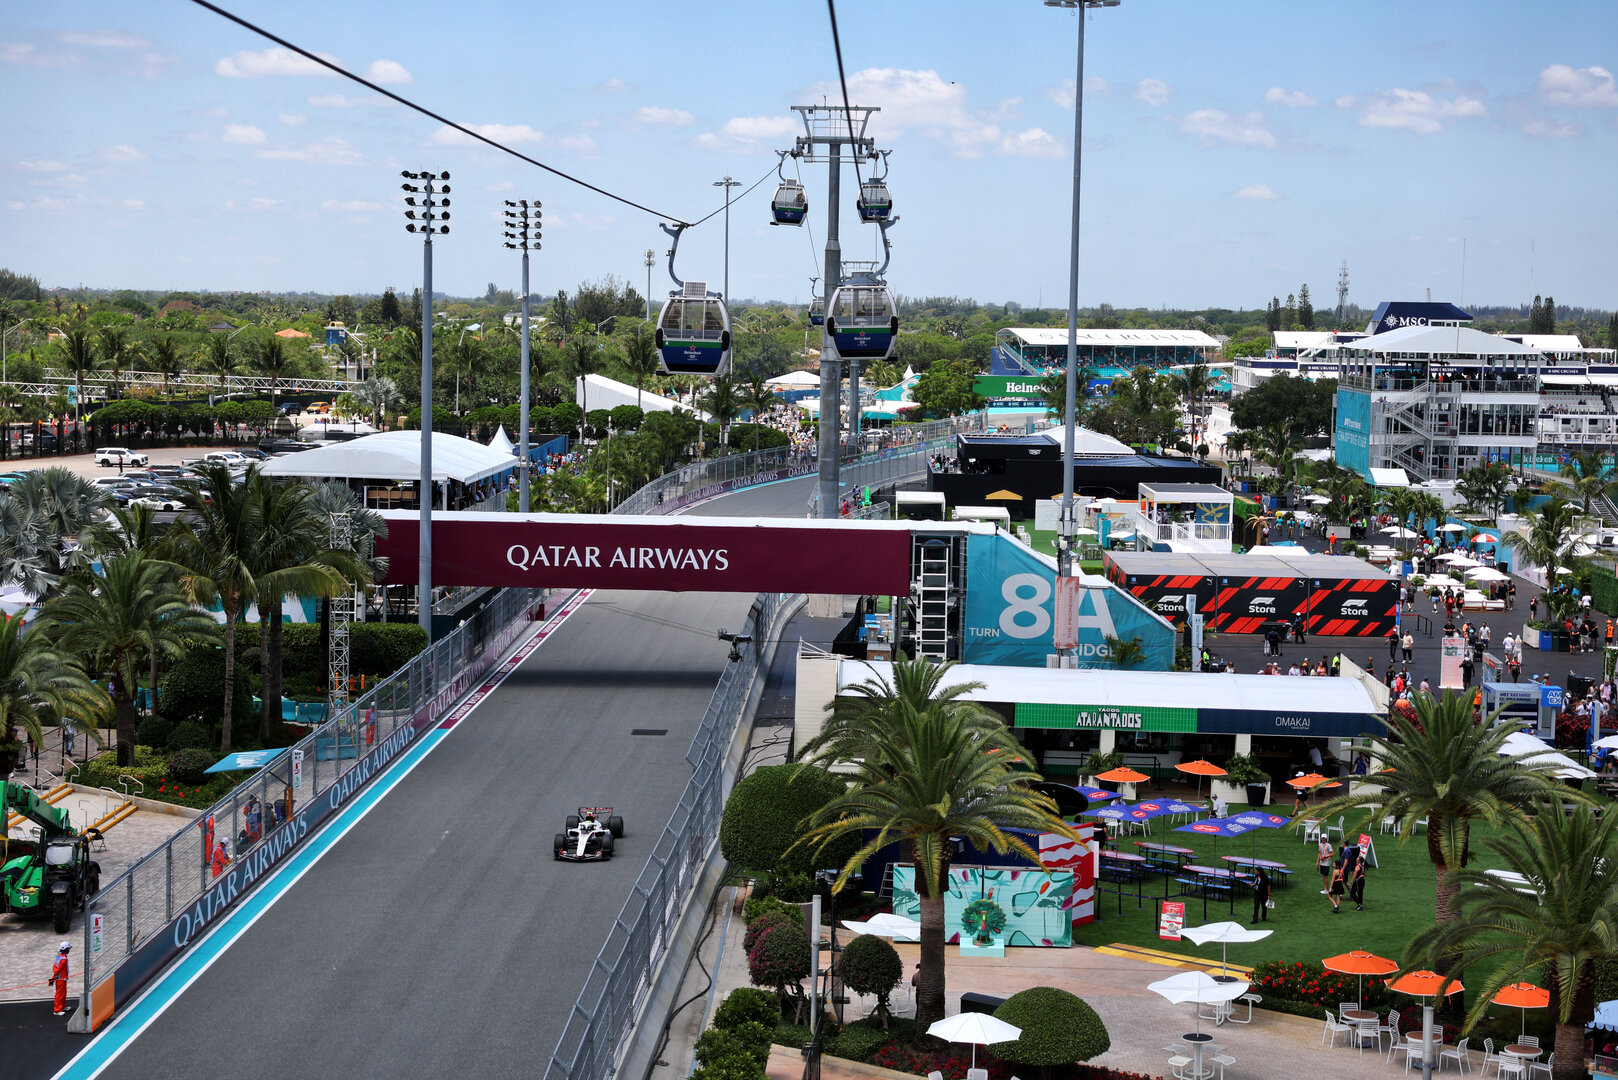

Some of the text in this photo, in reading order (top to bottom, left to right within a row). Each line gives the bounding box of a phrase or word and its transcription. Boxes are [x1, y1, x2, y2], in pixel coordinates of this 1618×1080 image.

[1399, 316, 1426, 327] MSC
[731, 471, 778, 490] QATAR AIRWAYS
[506, 544, 729, 571] QATAR AIRWAYS
[1157, 603, 1185, 612] Store
[1248, 605, 1276, 614] Store
[1340, 607, 1368, 616] Store
[969, 626, 1000, 638] TURN
[429, 659, 485, 722] QATAR AIRWAYS
[1076, 712, 1142, 728] ATARANTADOS
[1275, 717, 1311, 727] OMAKAI
[330, 718, 415, 809] QATAR AIRWAYS
[174, 810, 308, 948] QATAR AIRWAYS
[19, 895, 30, 904] 12
